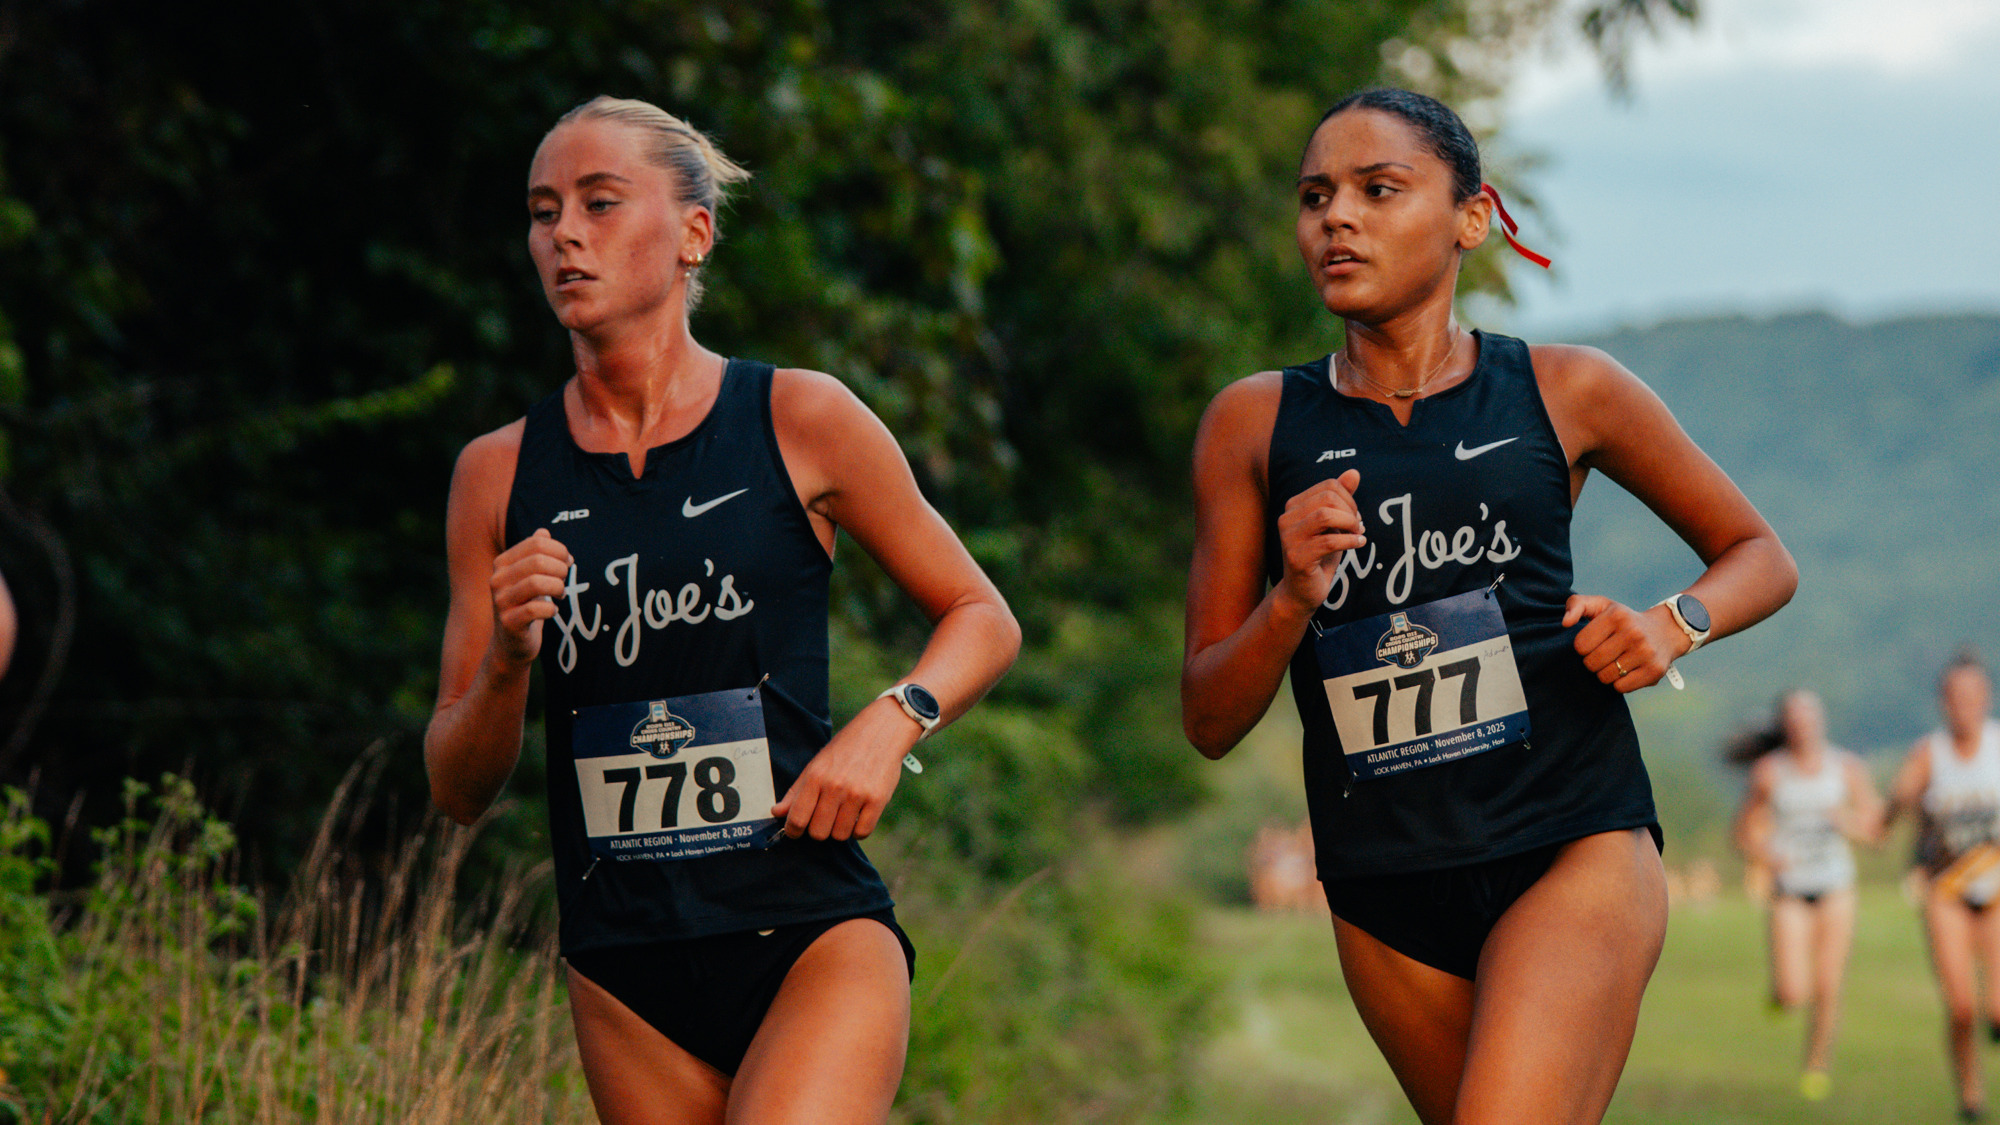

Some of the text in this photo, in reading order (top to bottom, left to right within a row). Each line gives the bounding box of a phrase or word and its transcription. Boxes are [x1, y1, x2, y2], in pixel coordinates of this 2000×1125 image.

[1378, 493, 1521, 605] Joe's
[604, 553, 755, 668] Joe's
[1378, 636, 1436, 658] CHAMPIONSHIPS
[1352, 656, 1481, 746] 777
[632, 729, 693, 744] CHAMPIONSHIPS
[1367, 721, 1506, 764] ATLANTIC REGION November 8, 2025
[1373, 765, 1390, 776] LOCK
[1414, 758, 1424, 767] PA
[1428, 755, 1442, 764] Lock
[1441, 751, 1462, 761] Haven
[1492, 737, 1506, 747] Host
[603, 756, 741, 833] 778
[610, 825, 753, 849] ATLANTIC REGION November 8, 2025
[656, 852, 666, 860] PA
[685, 848, 705, 856] Haven
